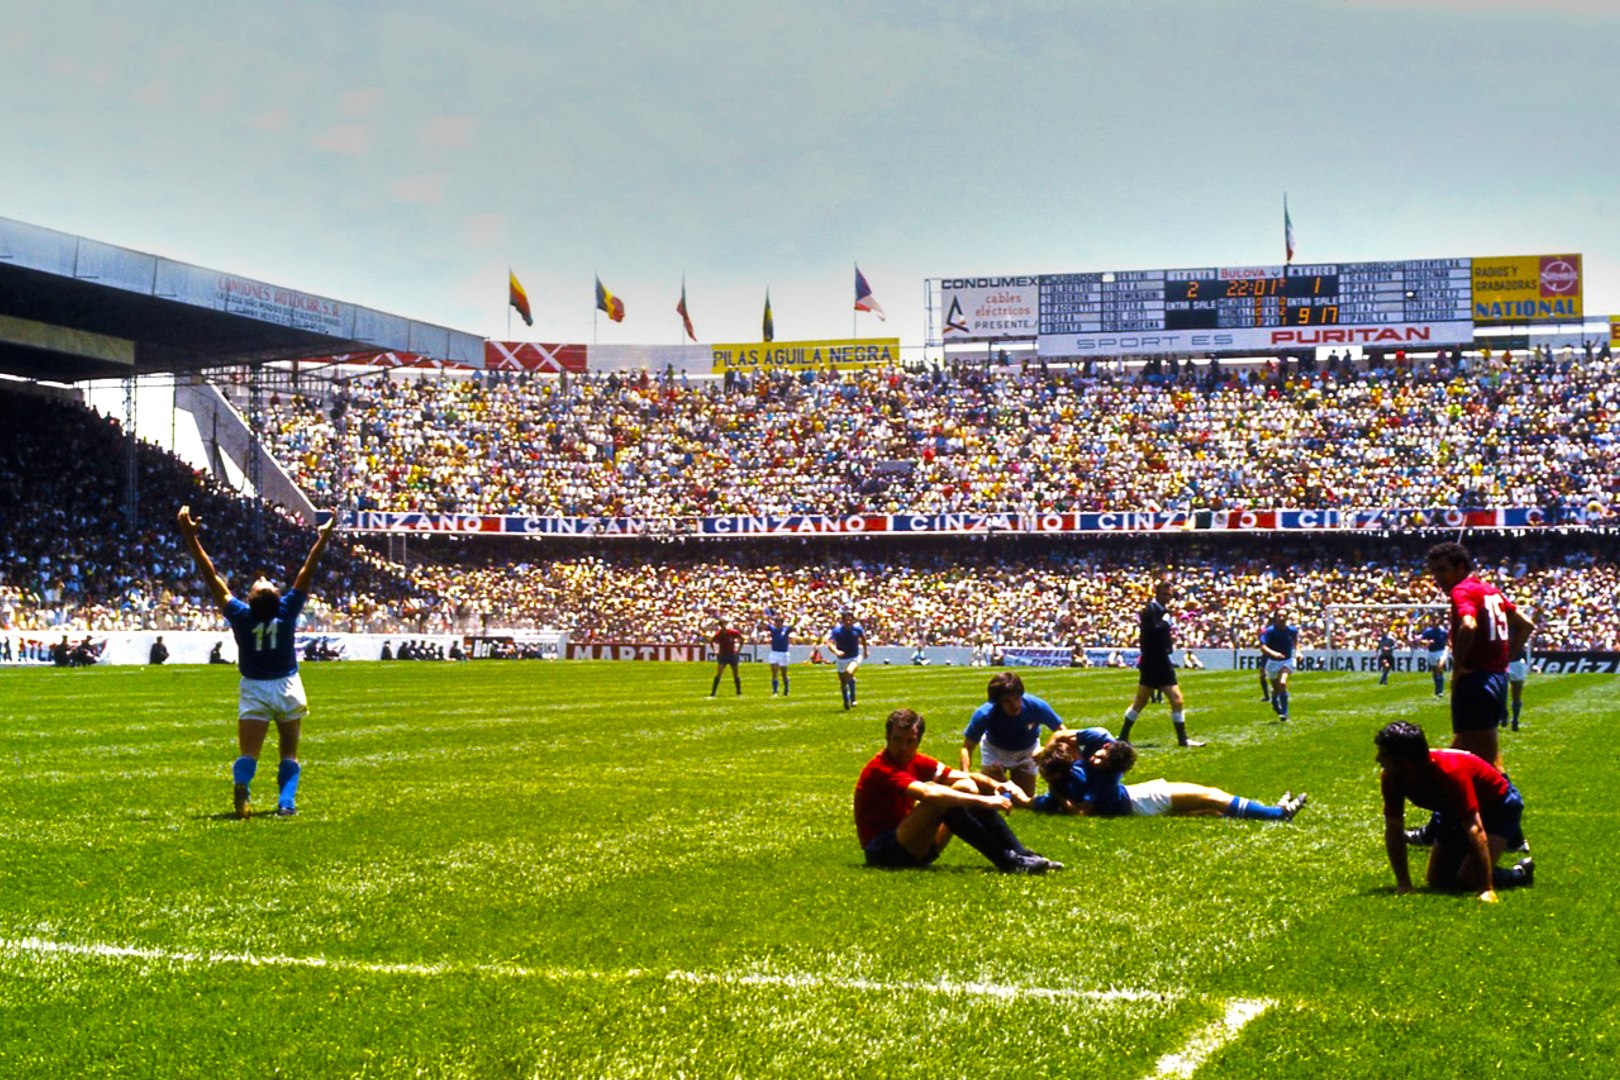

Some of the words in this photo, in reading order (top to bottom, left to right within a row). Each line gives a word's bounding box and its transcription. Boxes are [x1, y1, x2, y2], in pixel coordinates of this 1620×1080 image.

[1174, 270, 1210, 279] ITALIA
[1220, 268, 1265, 279] BULOVA
[941, 277, 1038, 289] CONDUMEX
[1187, 282, 1200, 298] 2
[1226, 280, 1278, 297] 22:01
[1314, 277, 1321, 294] 1
[985, 291, 1022, 303] cables
[1298, 307, 1310, 324] 9
[1320, 307, 1338, 323] 17
[1475, 299, 1578, 317] NATIONAL
[1076, 336, 1180, 350] SPORT
[1191, 334, 1234, 346] ES
[1271, 326, 1430, 344] PURITAN
[712, 350, 758, 367] PILAS
[764, 348, 822, 366] AGUILA
[829, 345, 891, 363] NEGRA
[714, 516, 865, 532] CINZANO
[1483, 593, 1509, 641] 15
[251, 620, 279, 651] 11
[573, 646, 702, 661] MARTINI
